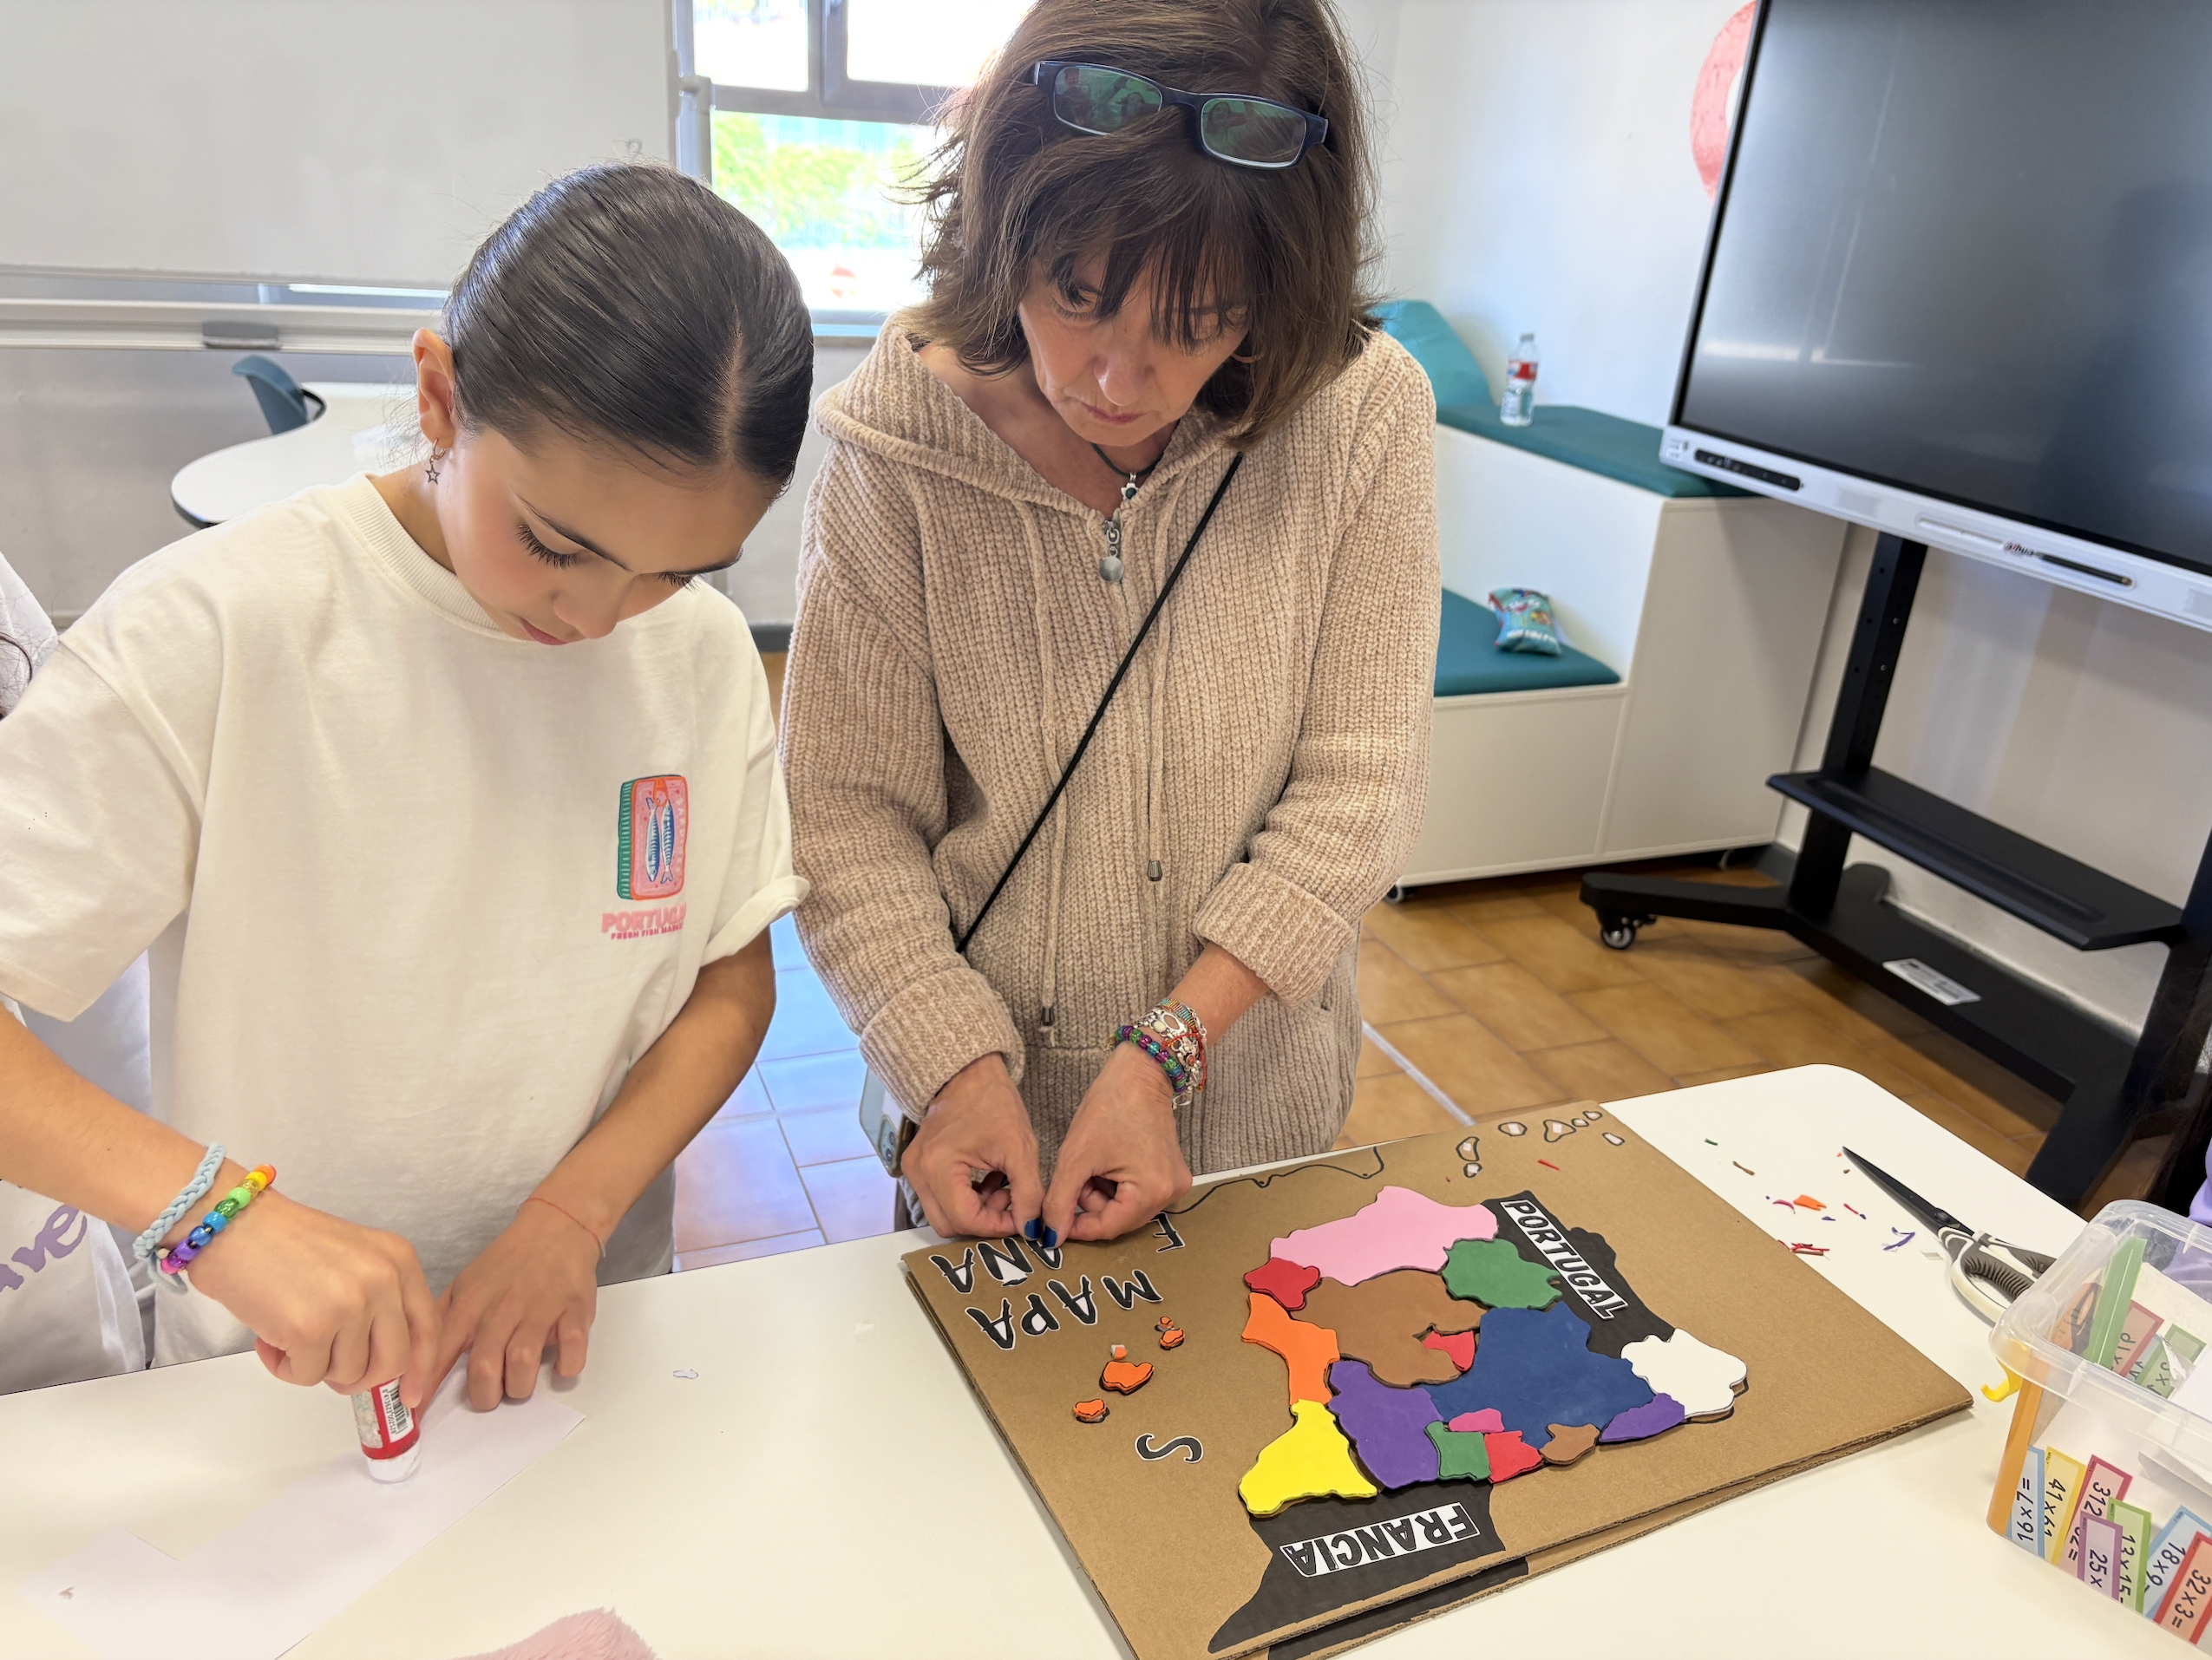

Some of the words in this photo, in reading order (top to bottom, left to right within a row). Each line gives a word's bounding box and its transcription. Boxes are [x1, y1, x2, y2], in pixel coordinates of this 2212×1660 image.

[611, 931, 639, 940] FRESH
[642, 928, 659, 937] FISH
[1503, 1201, 1626, 1318] PORTUGAL
[965, 1270, 1162, 1350] MAPA
[1135, 1434, 1203, 1463] S
[1282, 1505, 1478, 1576] FRANCIA
